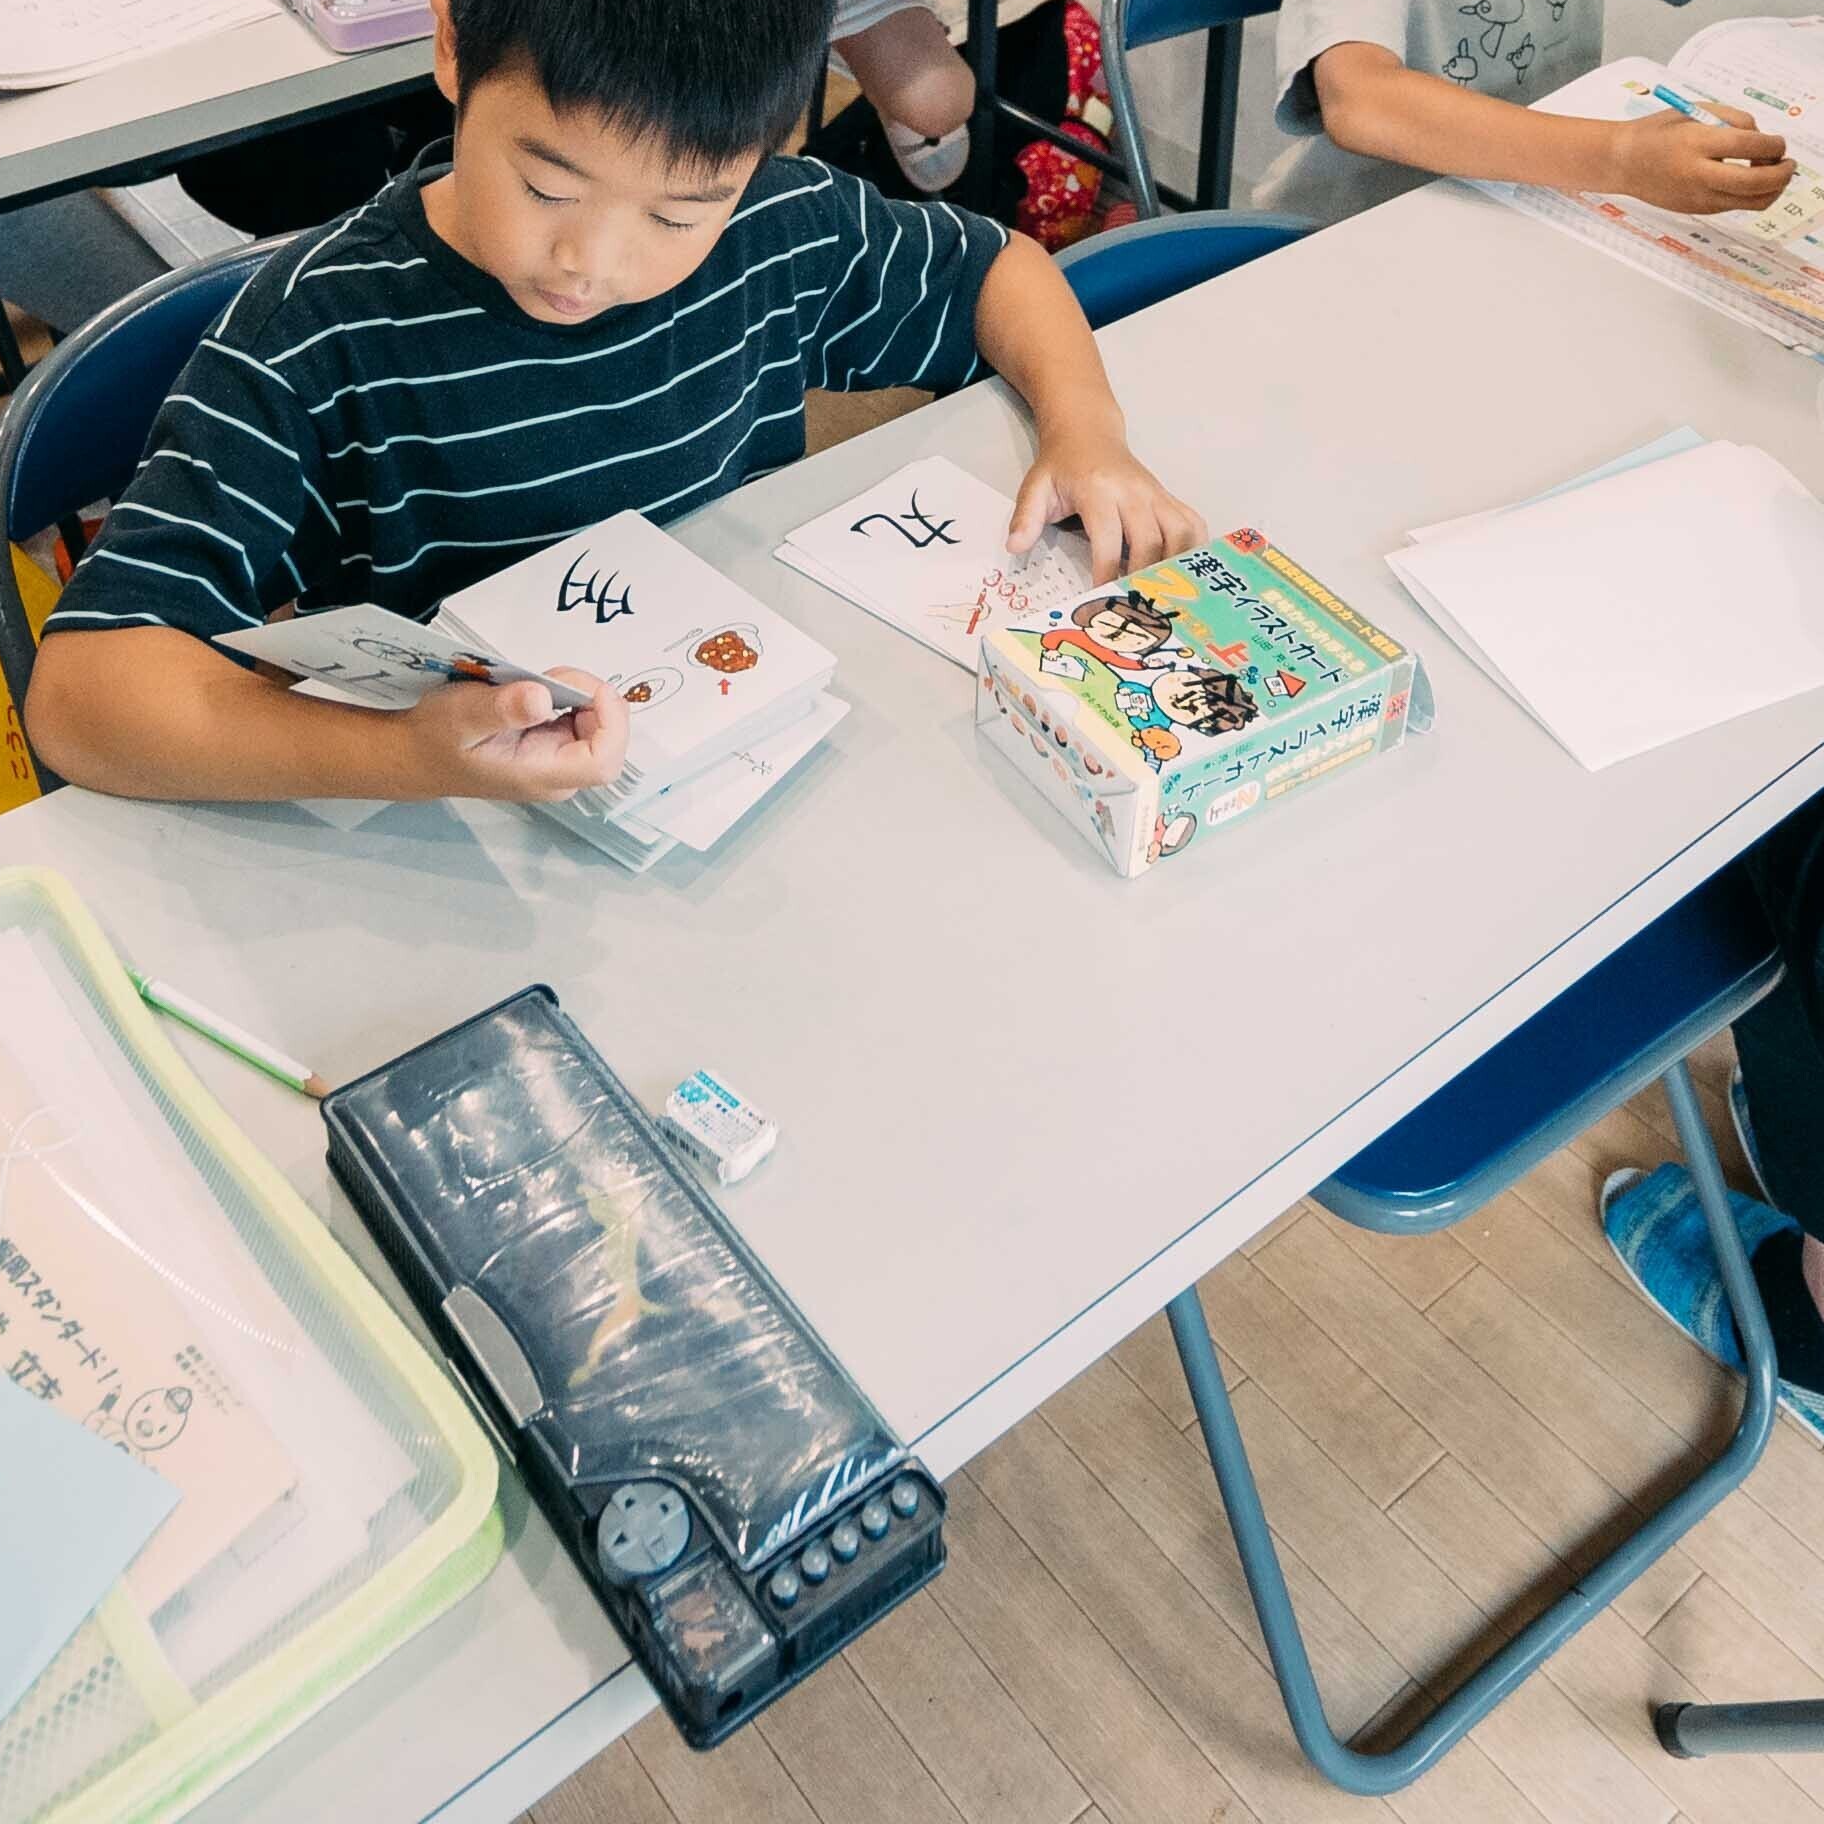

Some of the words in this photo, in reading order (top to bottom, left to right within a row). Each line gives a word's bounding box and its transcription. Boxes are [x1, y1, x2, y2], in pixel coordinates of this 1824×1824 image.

[556, 548, 635, 624] 多
[1179, 550, 1349, 684] 漢字イラストカード
[1206, 641, 1250, 669] 上
[1182, 692, 1383, 802] 漢字イラストカード
